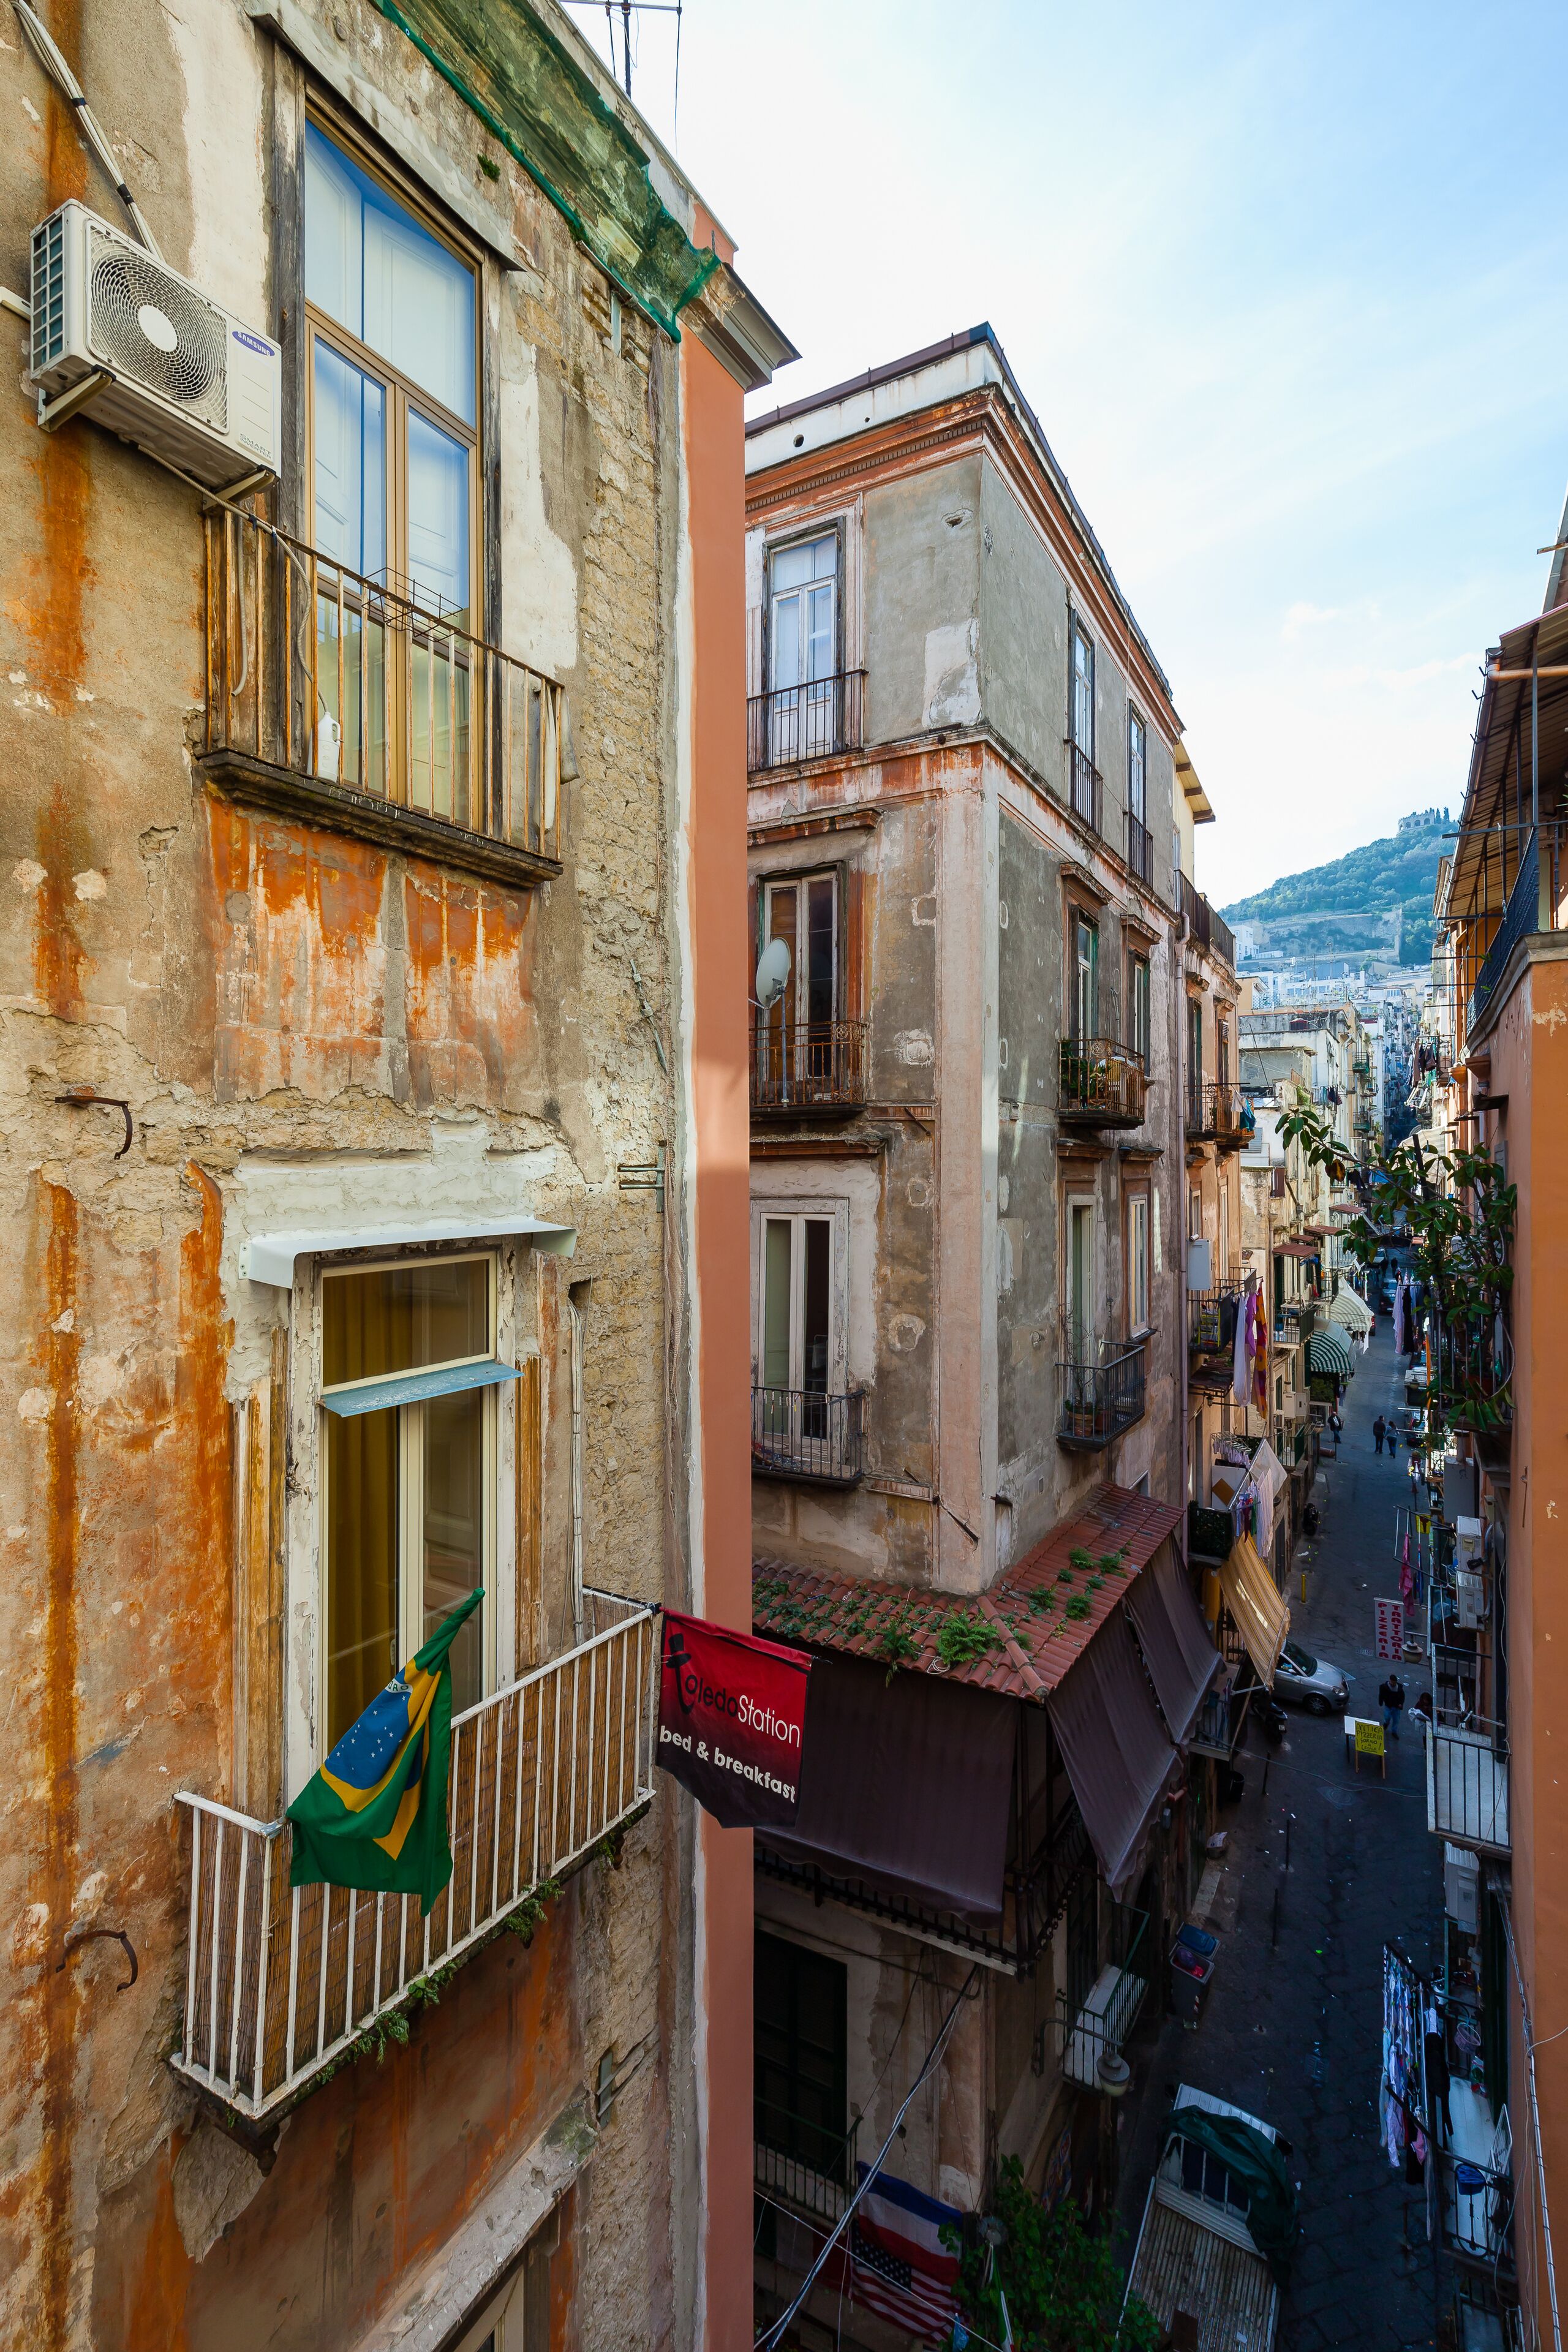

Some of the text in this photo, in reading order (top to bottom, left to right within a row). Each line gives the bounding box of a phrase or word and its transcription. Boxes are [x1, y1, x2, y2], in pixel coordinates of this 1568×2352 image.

[238, 331, 271, 356] SAMSUNG
[239, 433, 272, 455] SMART
[1378, 1602, 1389, 1659] PIZZERIA
[1390, 1605, 1403, 1661] TRATTORIA
[1357, 1723, 1383, 1734] ANTICA
[1357, 1730, 1382, 1740] PIZZERIA
[660, 1725, 796, 1803] bed & breakfast
